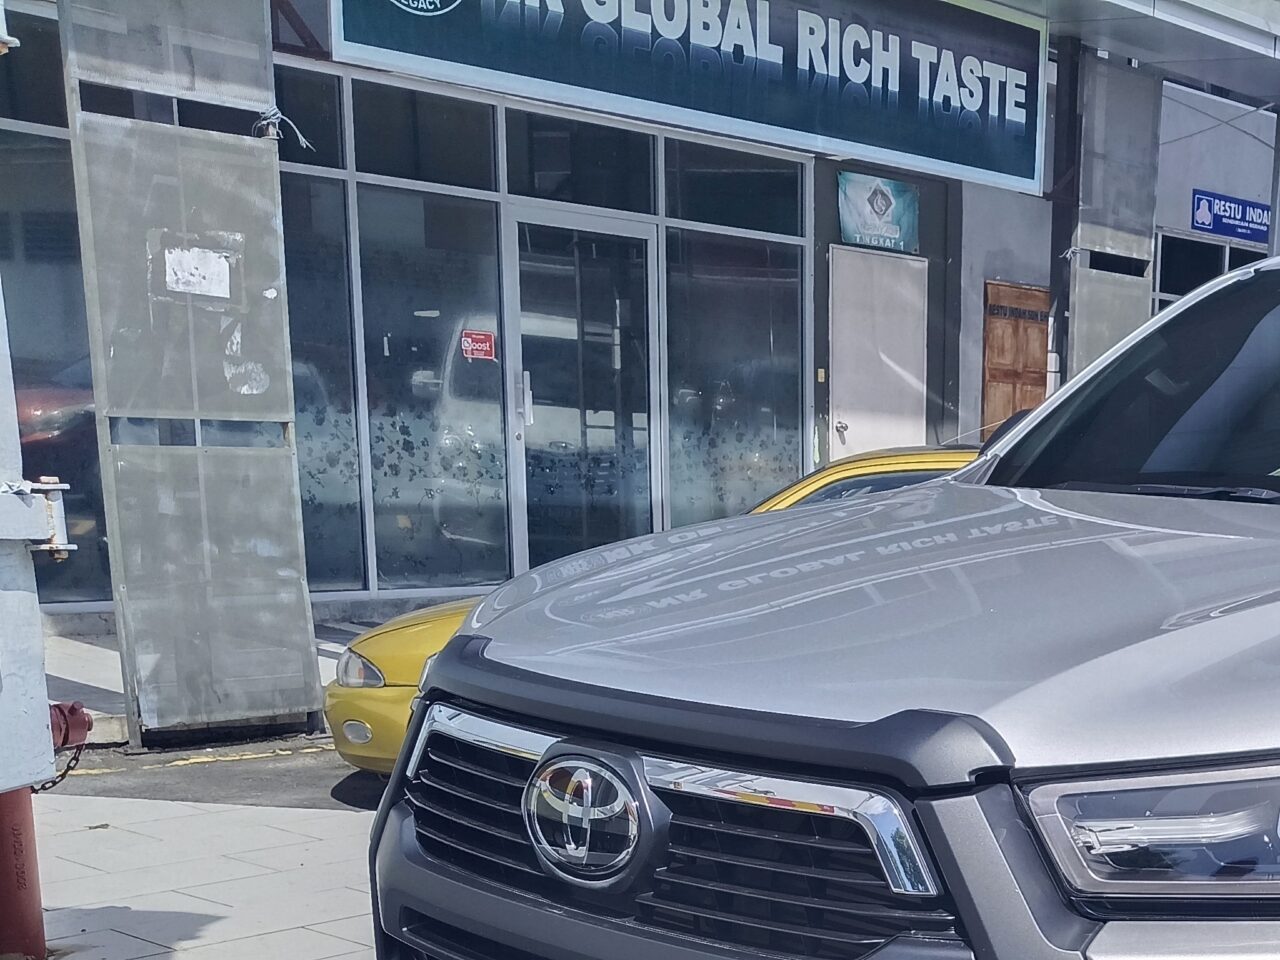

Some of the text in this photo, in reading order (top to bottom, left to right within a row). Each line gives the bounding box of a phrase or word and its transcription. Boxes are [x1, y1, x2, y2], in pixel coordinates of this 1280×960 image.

[797, 10, 900, 92] RICH
[911, 41, 1027, 123] TASTE
[1213, 199, 1242, 219] RESTU
[854, 234, 904, 251] TINGKAT 1
